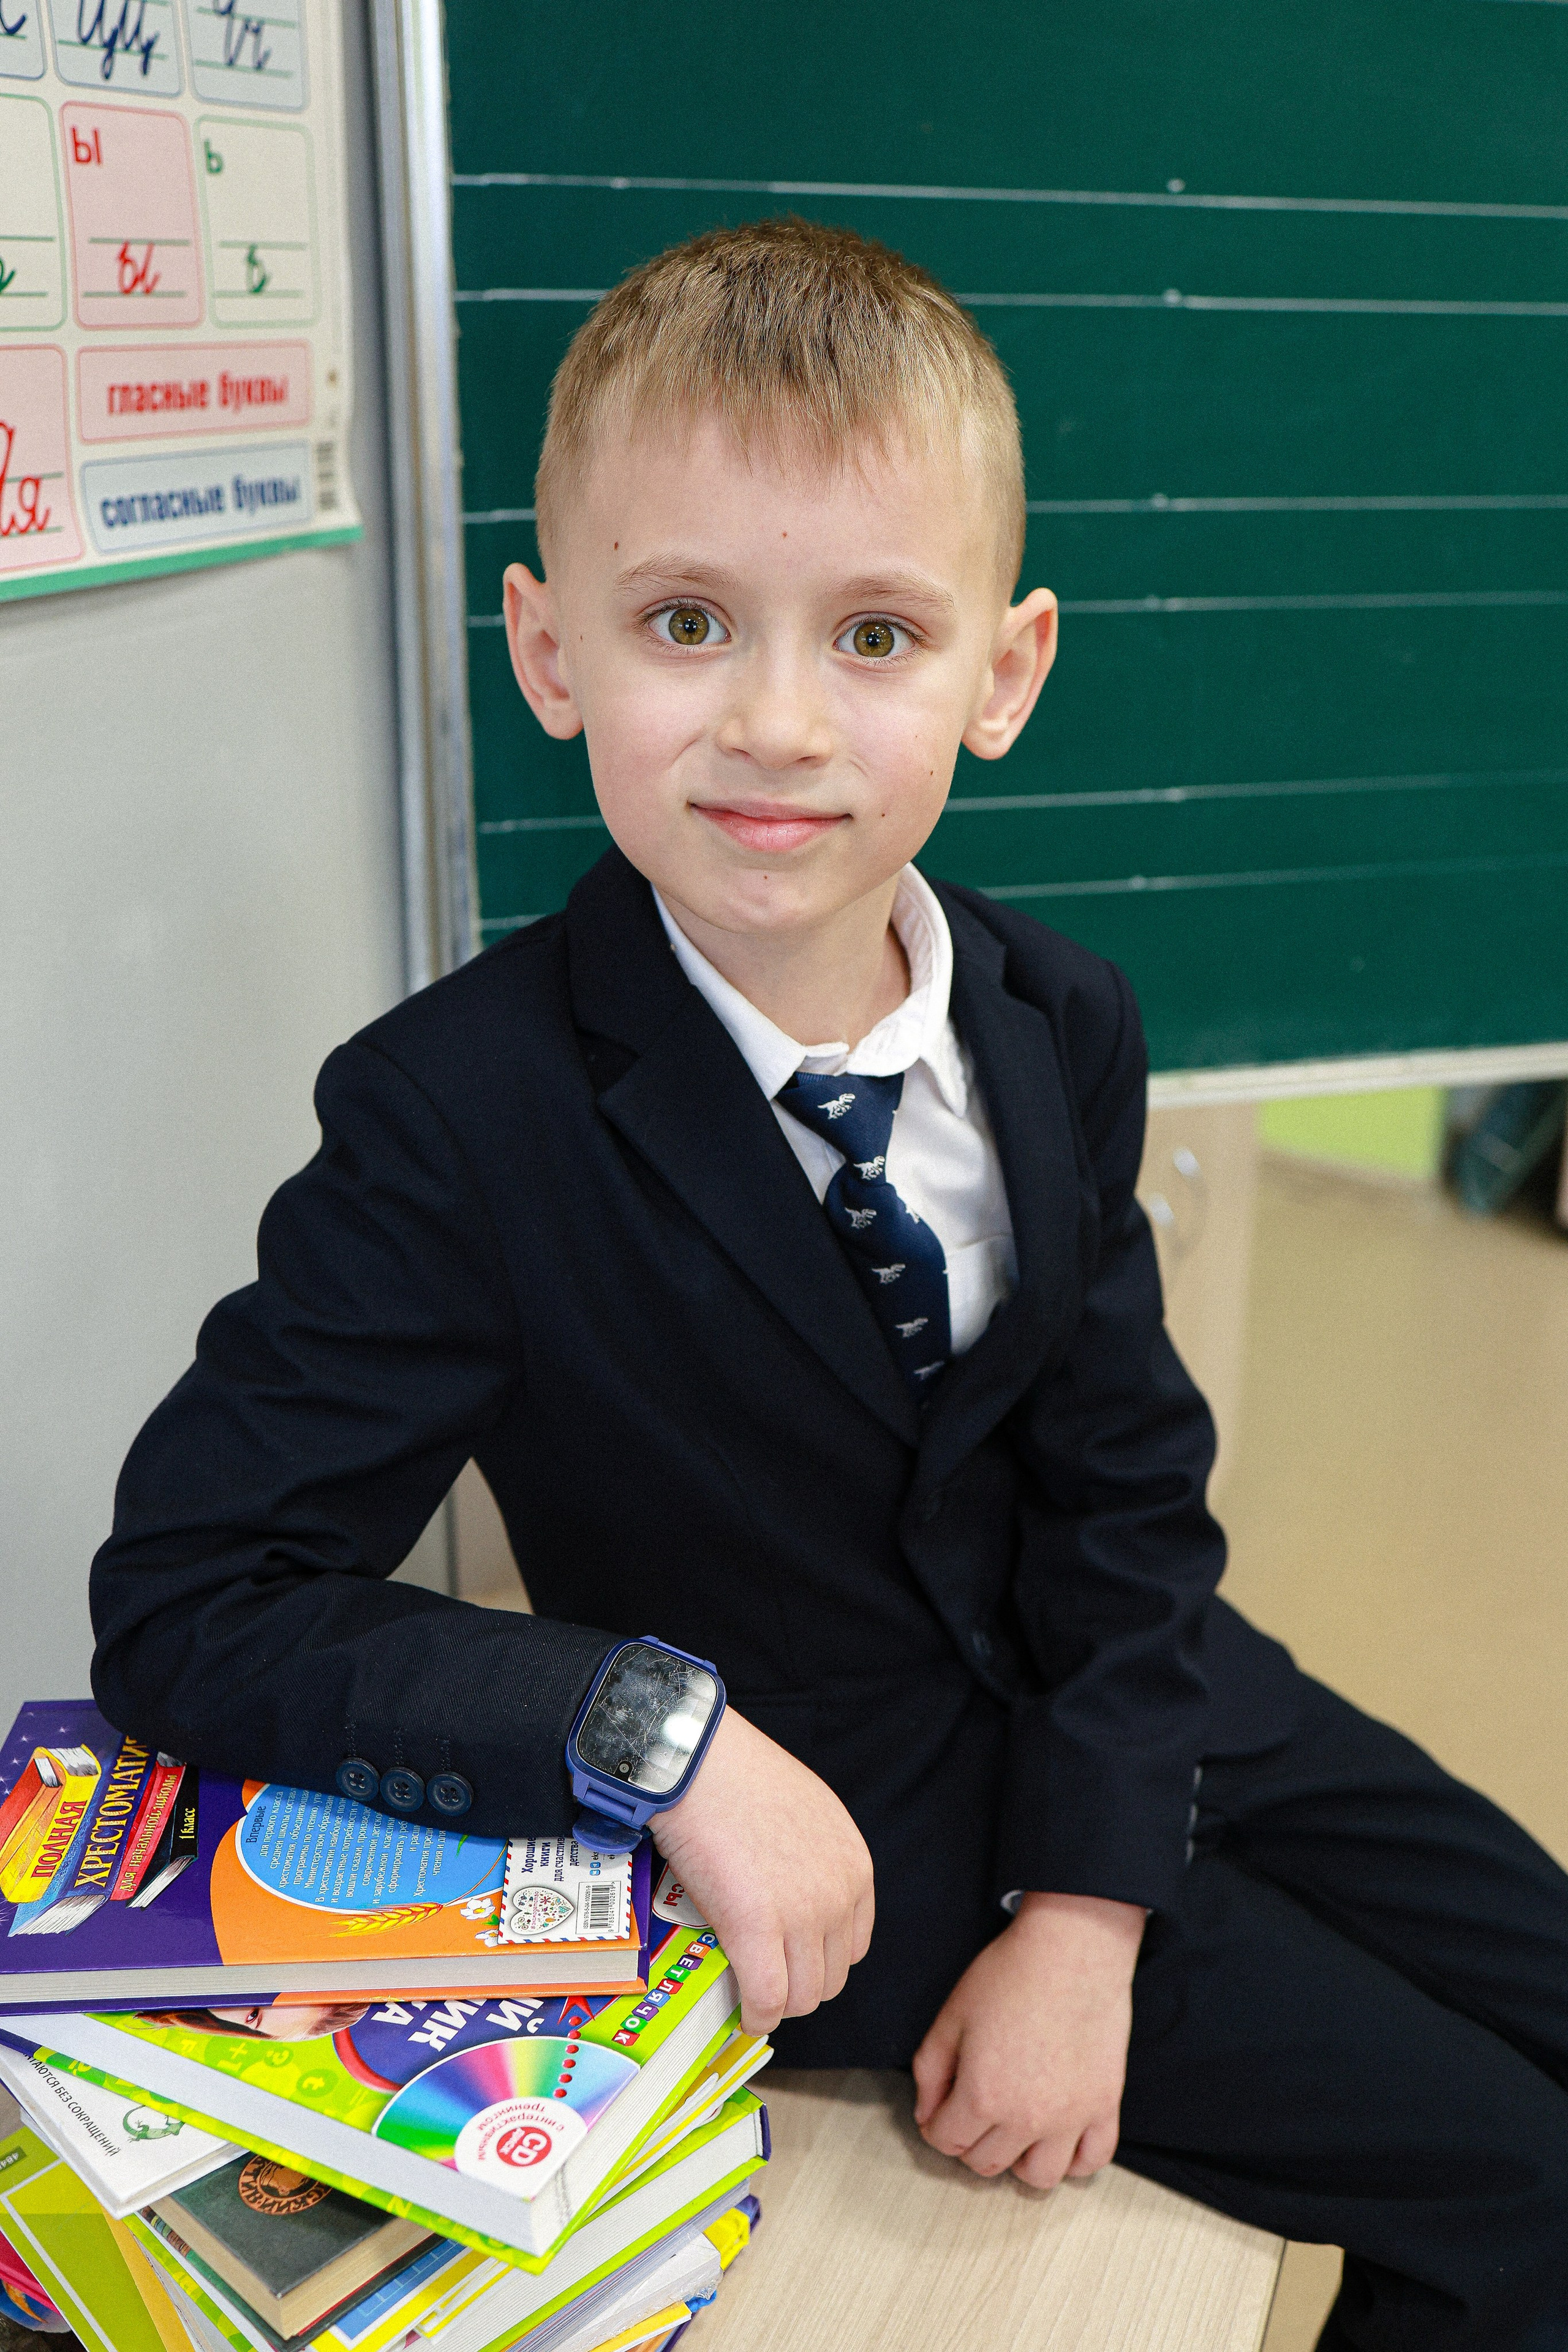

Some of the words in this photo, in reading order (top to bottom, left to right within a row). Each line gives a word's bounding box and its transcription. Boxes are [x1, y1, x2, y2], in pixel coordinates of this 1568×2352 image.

[107, 380, 208, 416] гласные
[217, 369, 289, 413] буквы
[101, 484, 222, 528] согласные
[233, 473, 300, 515] буквы
[129, 1809, 162, 1868] начальной
[154, 1774, 178, 1810] школы
[246, 1806, 266, 1843] Впервые
[271, 1791, 284, 1813] класса
[306, 1804, 320, 1832] чтению,
[31, 1800, 88, 1878] ПОЛНАЯ
[260, 1844, 270, 1857] для
[263, 1815, 277, 1842] первого
[270, 1840, 284, 1869] средней
[278, 1815, 291, 1838] школы
[304, 1834, 312, 1842] по
[332, 1853, 348, 1896] возрастные
[342, 1807, 358, 1851] потребности
[278, 1841, 297, 1888] хрестоматия,
[293, 1844, 310, 1885] программы
[304, 1833, 324, 1888] Министерством
[318, 1849, 336, 1894] хрестоматии
[330, 1815, 344, 1847] наиболее
[345, 1873, 357, 1898] вошли
[352, 1844, 364, 1872] сказки,
[362, 1838, 379, 1887] современной
[374, 1853, 389, 1897] зарубежной
[383, 1817, 395, 1849] классики
[387, 1840, 405, 1893] сформировать
[413, 1851, 429, 1897] Хрестоматия
[433, 1850, 443, 1875] чтения
[438, 1830, 447, 1842] для
[521, 1837, 537, 1873] Хорошие
[540, 1842, 551, 1867] книги
[554, 1869, 564, 1882] для
[570, 1841, 579, 1866] детства
[55, 2086, 72, 2103] БЕЗ
[67, 2101, 121, 2157] СОКРАЩЕНИЙ
[510, 2132, 548, 2165] CD
